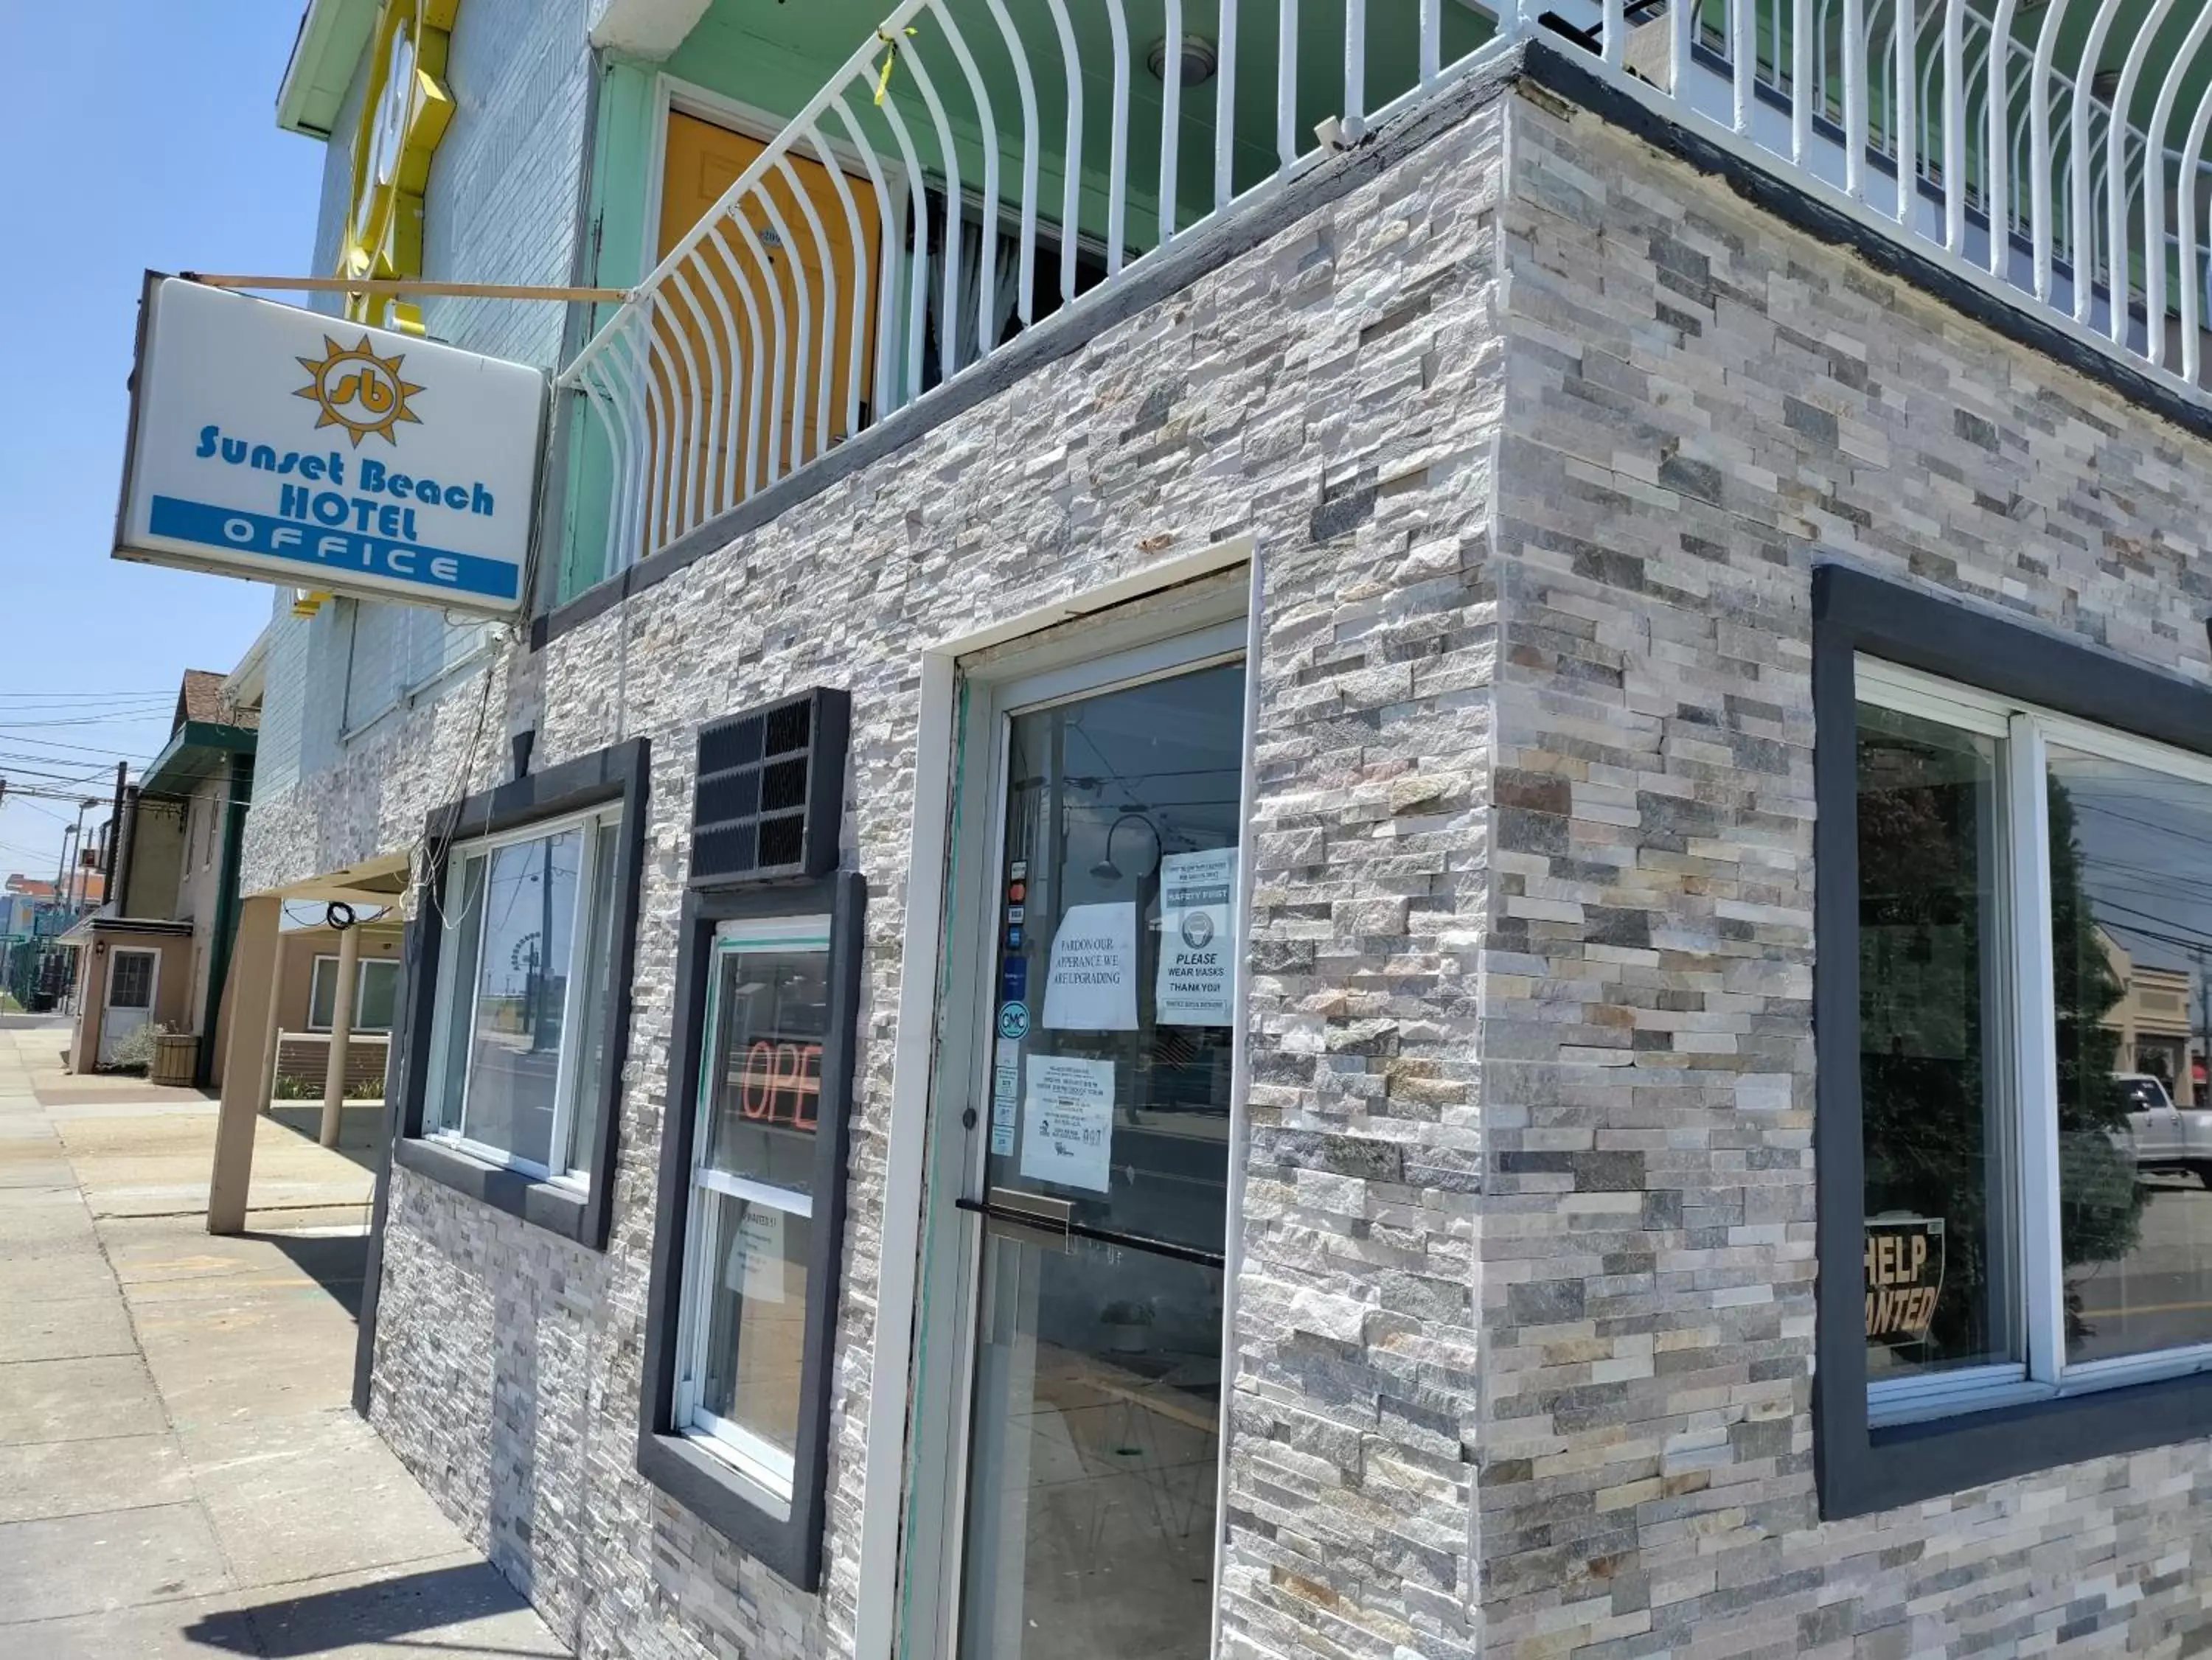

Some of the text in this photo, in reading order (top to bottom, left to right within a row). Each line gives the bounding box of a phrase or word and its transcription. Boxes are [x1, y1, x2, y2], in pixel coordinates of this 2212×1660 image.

[195, 425, 495, 516] Sunset Beach
[279, 483, 418, 542] HOTEL
[223, 517, 459, 582] OFFICE
[1061, 937, 1114, 951] PARDON OUR
[1175, 952, 1219, 965] PLEASE
[1167, 966, 1226, 977] WEAR MASKS
[1168, 983, 1200, 991] THANK
[742, 1039, 824, 1129] OPE
[1865, 1286, 1937, 1336] ANTED
